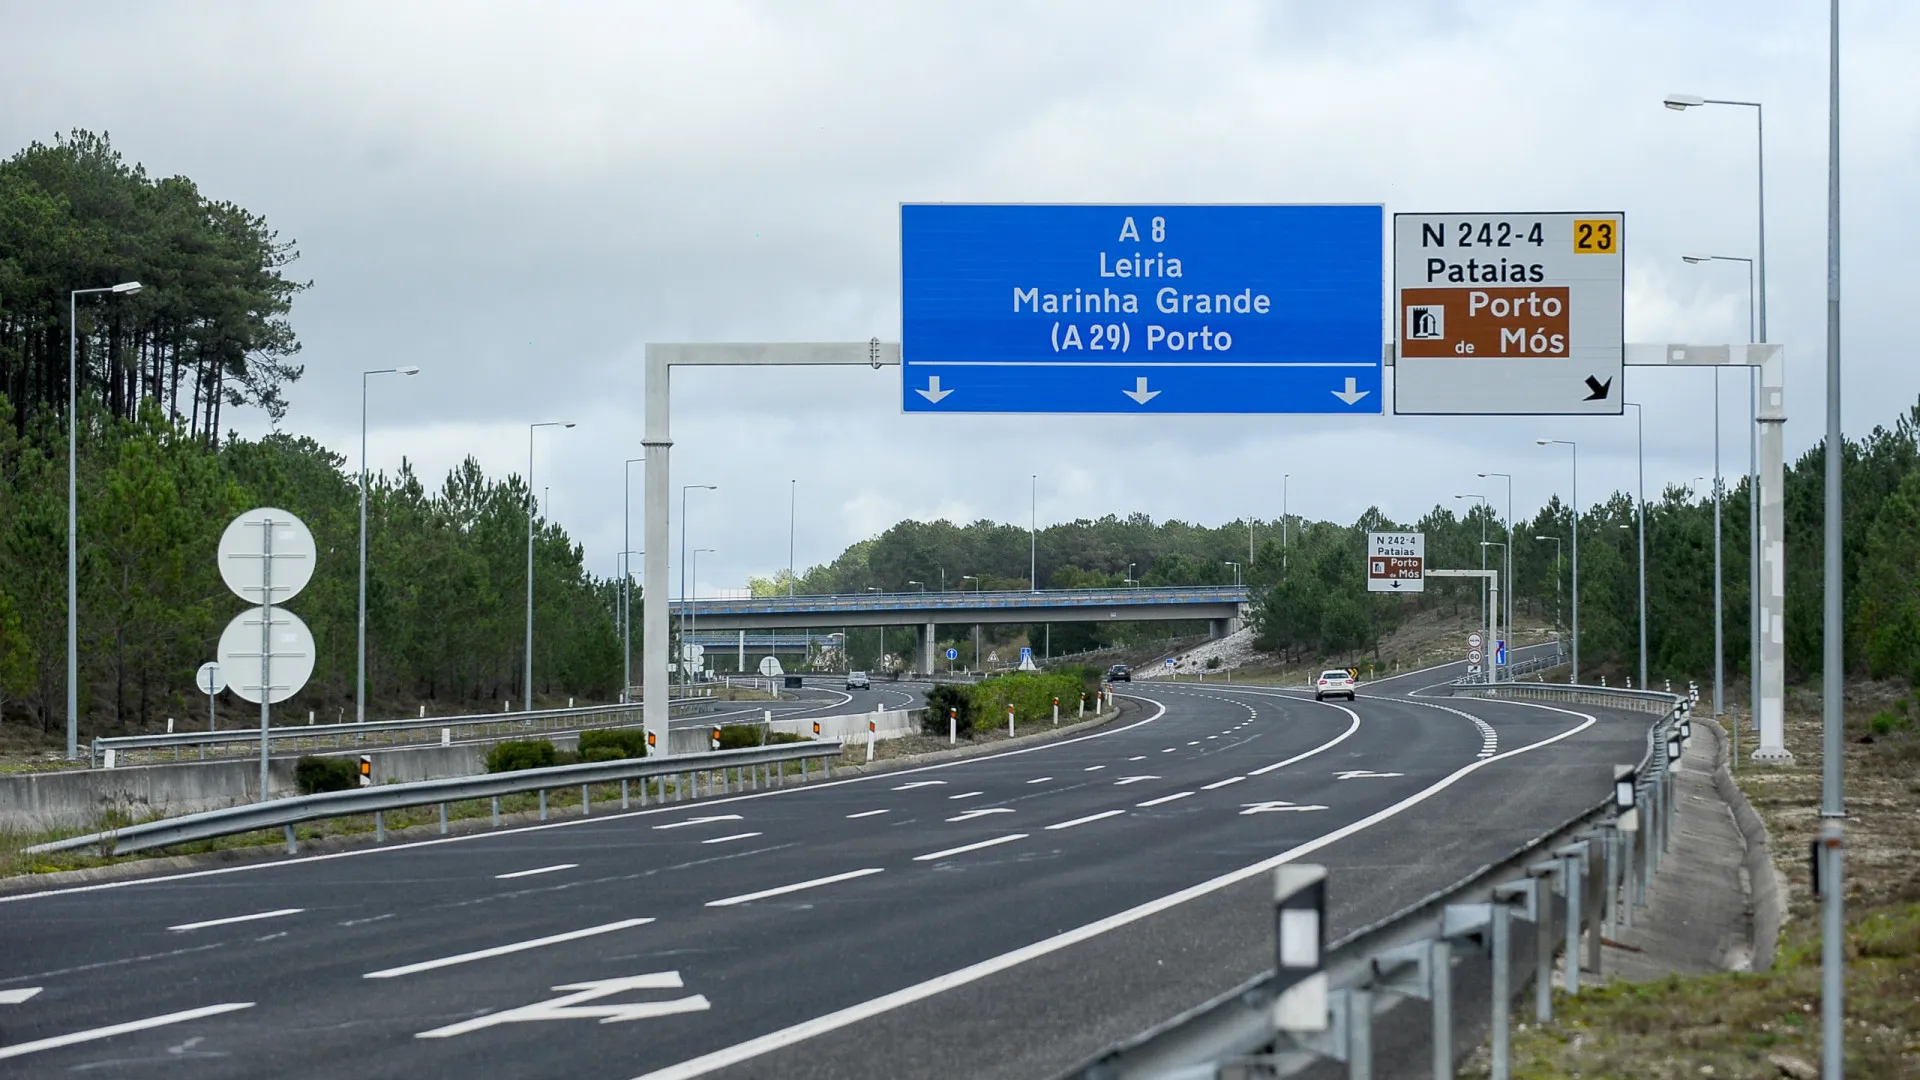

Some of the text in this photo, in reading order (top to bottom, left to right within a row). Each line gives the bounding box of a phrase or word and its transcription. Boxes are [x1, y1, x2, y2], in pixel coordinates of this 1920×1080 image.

[1118, 217, 1166, 243] A 8
[1422, 222, 1544, 248] N 242-4
[1578, 224, 1613, 250] 23
[1100, 252, 1183, 278] Leiria
[1427, 258, 1544, 283] Pataias
[1013, 287, 1271, 314] Marinha Grande
[1469, 291, 1562, 318] Porto
[1147, 325, 1232, 351] Porto
[1455, 327, 1565, 354] de Mós
[1377, 536, 1416, 545] N 242-4
[1378, 547, 1415, 556] Pataias
[1391, 558, 1418, 567] Porto
[1399, 569, 1420, 578] Mós
